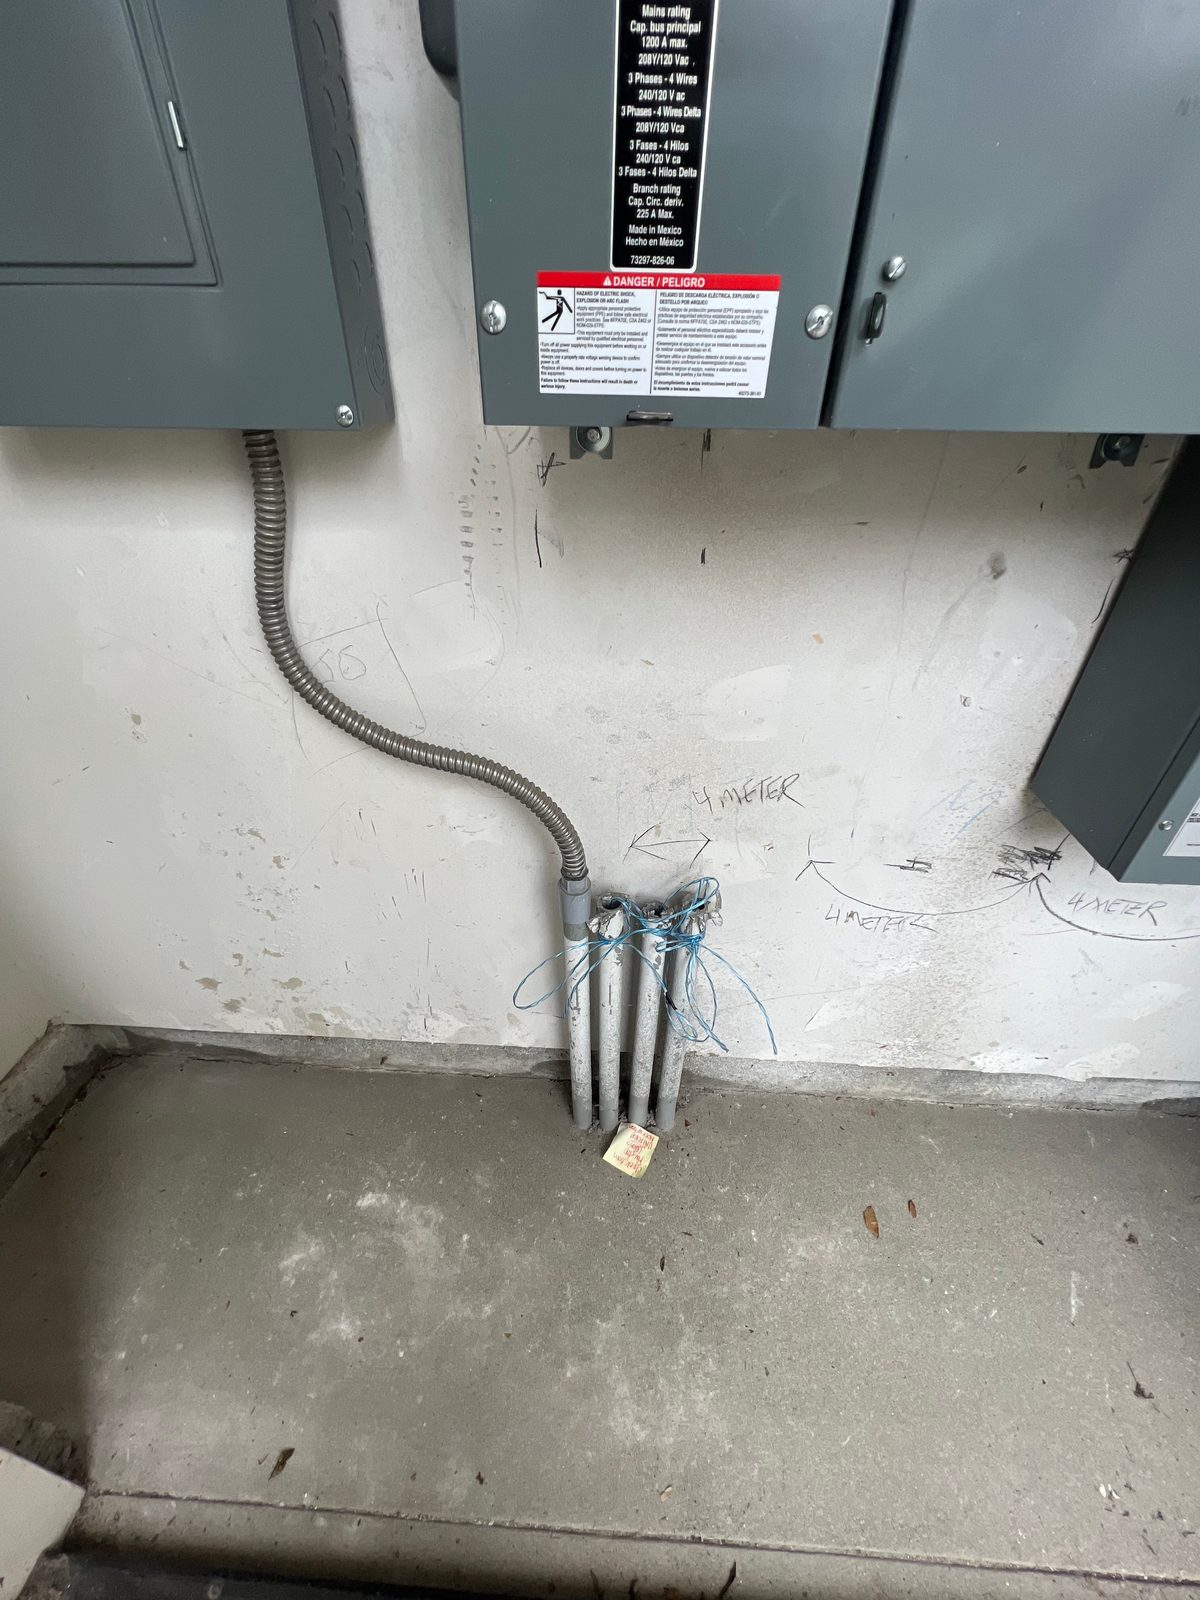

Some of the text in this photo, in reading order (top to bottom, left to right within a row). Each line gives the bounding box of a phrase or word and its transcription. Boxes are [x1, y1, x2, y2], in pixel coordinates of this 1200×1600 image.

[642, 4, 690, 20] Mains rating
[630, 20, 701, 35] Cap. bus principal
[642, 36, 688, 48] 1200 A max.
[638, 54, 689, 65] 208Y/120 Vac
[628, 72, 632, 84] 3
[635, 72, 662, 84] Phases
[669, 73, 673, 84] 4
[676, 73, 697, 84] Wires
[639, 90, 685, 101] 240/120 V ac
[621, 106, 625, 116] 3
[627, 106, 652, 117] Phases
[657, 106, 661, 116] 4
[663, 106, 682, 117] Wires
[684, 106, 701, 117] Delta
[636, 122, 684, 133] 208Y/120 Vca
[630, 140, 634, 150] 3
[636, 140, 657, 150] Fases
[664, 140, 668, 150] 4
[670, 140, 689, 151] Hilos
[636, 153, 681, 164] 240/120 V ca
[619, 167, 623, 176] 3
[625, 166, 646, 176] Fases
[652, 167, 656, 176] 4
[659, 167, 676, 177] Hilos
[678, 167, 697, 178] Delta
[633, 183, 681, 196] Branch rating
[628, 196, 684, 207] Cap. Circ. deriv.
[637, 209, 674, 219] 225 A Max.
[629, 224, 682, 235] Made in Mexico
[626, 236, 648, 246] Hecho
[660, 237, 684, 247] México
[631, 256, 674, 265] 73297-826-06
[614, 277, 654, 286] DANGER
[662, 277, 705, 287] PELIGRO
[692, 773, 806, 815] 4 METER
[824, 903, 841, 926] 4
[1067, 891, 1168, 927] 4 METER
